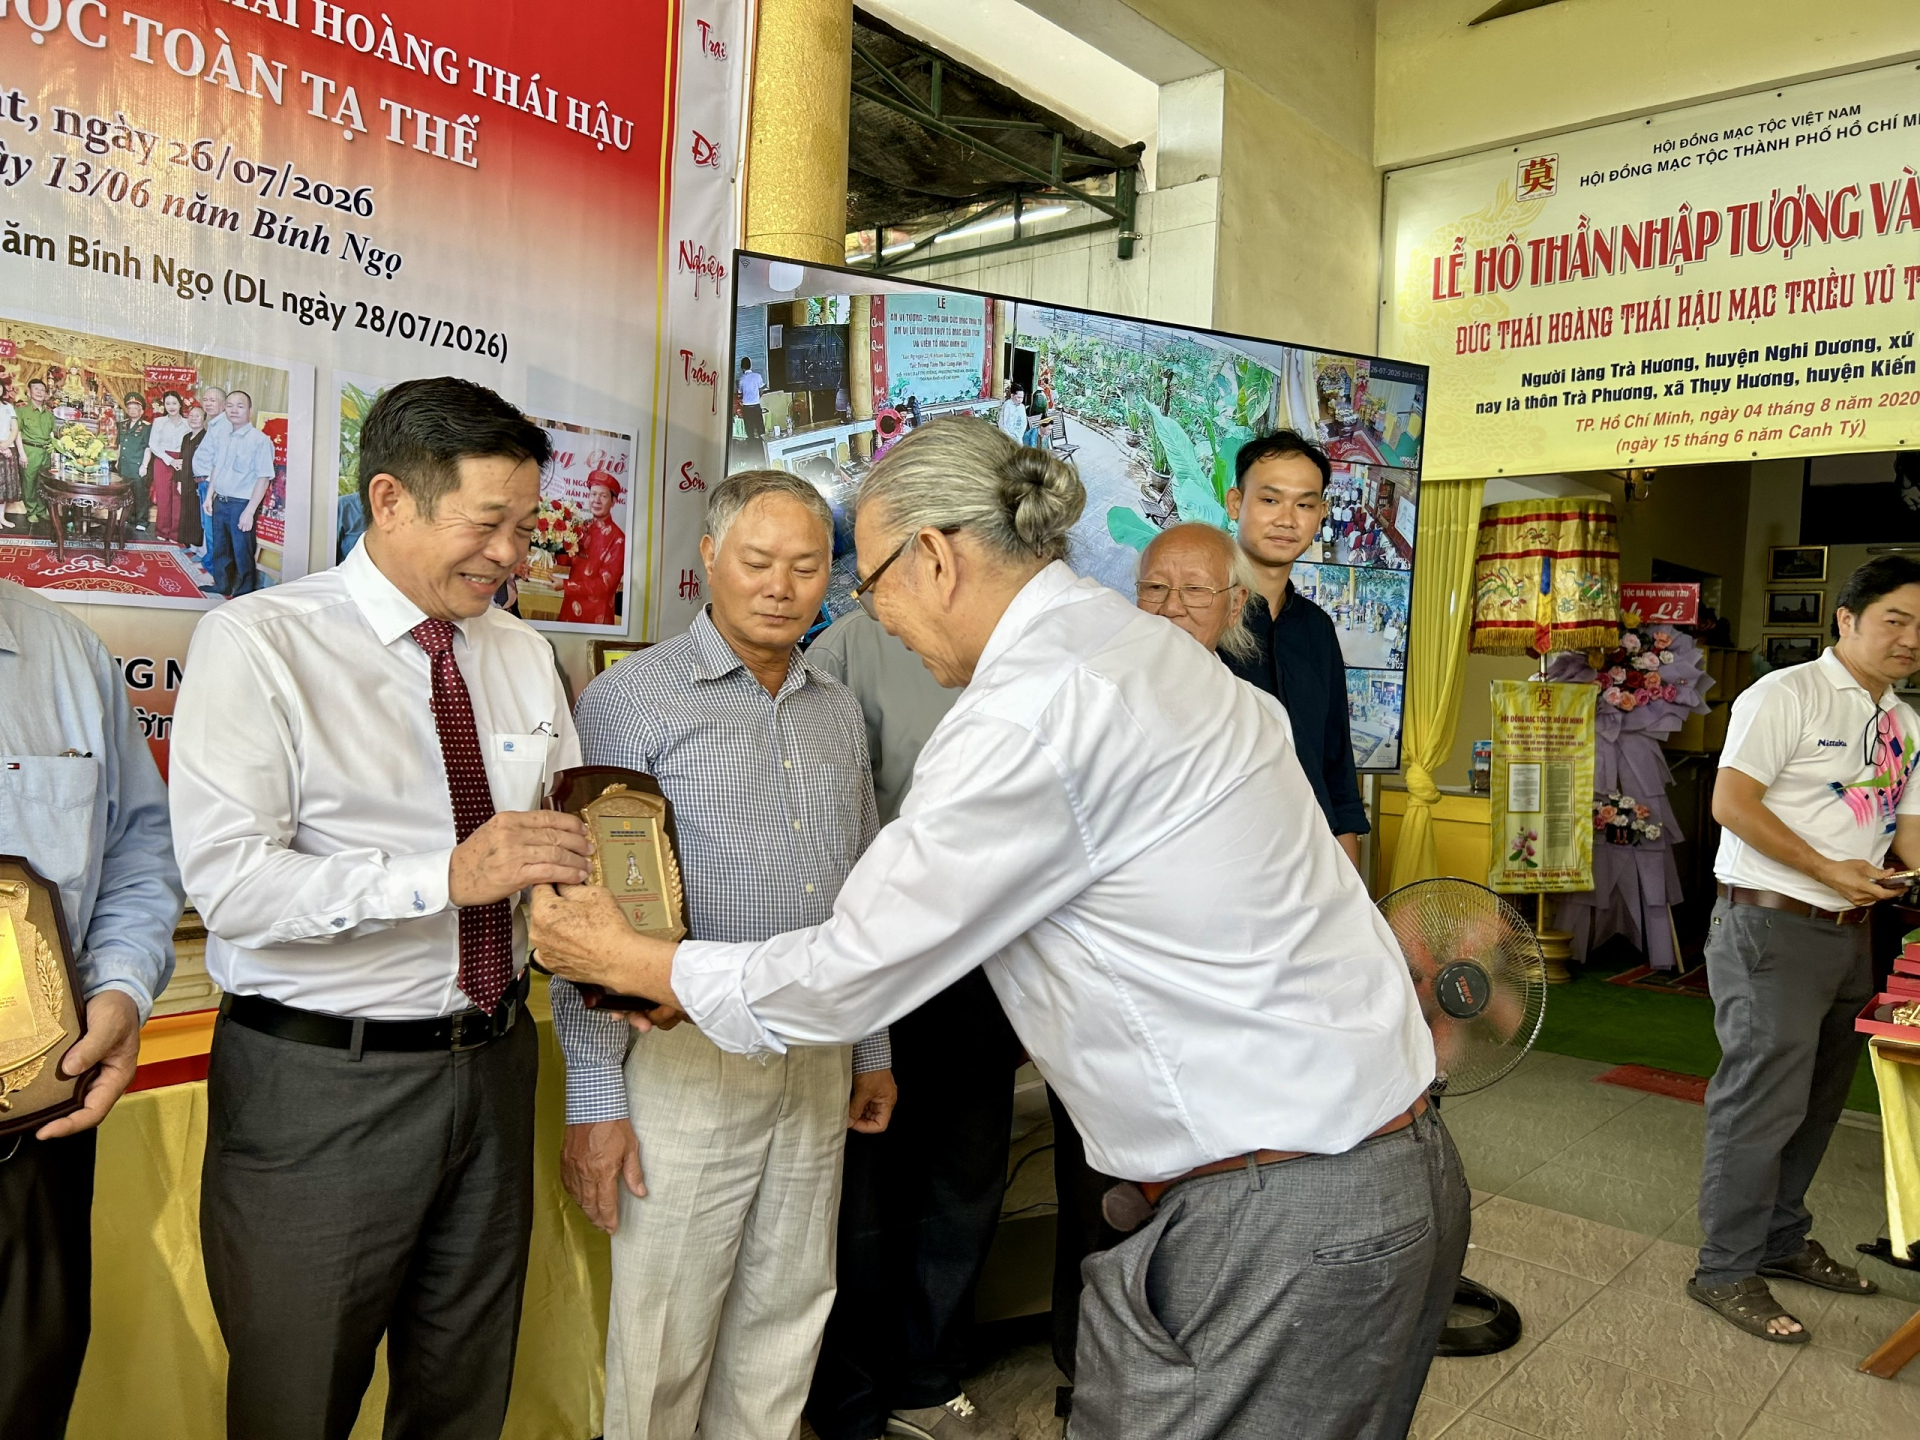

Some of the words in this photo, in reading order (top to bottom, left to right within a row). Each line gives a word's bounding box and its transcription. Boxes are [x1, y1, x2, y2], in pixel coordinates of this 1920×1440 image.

[0, 0, 107, 47] ỌC
[123, 11, 287, 105] TOÀN
[301, 70, 367, 141] TẠ
[380, 92, 480, 168] THẾ
[311, 0, 459, 84] HOÀNG
[468, 57, 558, 124] THÁI
[566, 100, 634, 151] HẬU
[53, 108, 160, 167] ngày
[168, 140, 374, 217] 26/07/2026
[1580, 171, 1605, 187] HỘI
[1609, 163, 1653, 182] ĐỒNG
[1657, 156, 1692, 172] MẠC
[1696, 149, 1728, 166] TỘC
[1734, 138, 1789, 158] THÀNH
[1795, 125, 1832, 147] PHỐ
[1837, 120, 1862, 139] HỒ
[1867, 114, 1899, 134] CHÍ
[1653, 140, 1676, 154] HỘI
[1680, 132, 1719, 148] ĐỒNG
[1723, 126, 1754, 140] MẠC
[1758, 119, 1787, 133] TỘC
[1792, 111, 1824, 127] VIỆT
[1828, 105, 1861, 120] NAM
[45, 156, 152, 208] 13/06
[161, 191, 240, 232] năm
[249, 207, 330, 255] Bính
[339, 231, 402, 280] Ngọ
[1432, 236, 1465, 302] LỄ
[1473, 233, 1523, 295] HÔ
[1527, 213, 1616, 287] THẦN
[1620, 202, 1721, 275] NHẬP
[1726, 184, 1862, 260] TƯỢNG
[67, 234, 142, 280] Bính
[152, 253, 214, 301] Ngọ
[223, 269, 274, 305] (DL
[282, 290, 347, 331] ngày
[354, 301, 508, 364] 28/07/2026)
[1456, 321, 1491, 355] ĐỨC
[1497, 313, 1543, 350] THÁI
[1548, 306, 1614, 345] HOÀNG
[1621, 295, 1671, 335] THÁI
[1677, 289, 1723, 331] HẬU
[1728, 284, 1778, 325] MẠC
[1785, 267, 1856, 315] TRIỀU
[1864, 264, 1896, 306] VŨ
[680, 349, 717, 412] Tráng
[1476, 401, 1502, 415] nay
[1506, 397, 1521, 412] là
[1525, 393, 1558, 410] thôn
[1563, 390, 1587, 406] Trà
[1592, 386, 1659, 404] Phương,
[1663, 380, 1685, 398] xã
[1690, 377, 1732, 396] Thụy
[1736, 371, 1801, 390] Hương,
[1806, 363, 1865, 384] huyện
[1871, 355, 1916, 378] Kiến
[1521, 368, 1566, 388] Người
[1571, 366, 1606, 384] làng
[1611, 361, 1636, 378] Trà
[1641, 356, 1700, 375] Hương,
[1705, 349, 1759, 368] huyện
[1765, 342, 1809, 362] Nghi
[1815, 337, 1882, 357] Dương,
[1888, 331, 1915, 350] xứ
[1576, 418, 1595, 433] TP.
[1600, 414, 1621, 431] Hồ
[1624, 412, 1651, 429] Chí
[1653, 410, 1695, 427] Minh,
[1700, 406, 1740, 425] ngày
[1743, 404, 1763, 419] 04
[1767, 400, 1816, 417] tháng
[1820, 398, 1831, 412] 8
[1835, 395, 1873, 411] năm
[1878, 391, 1920, 408] 2020
[1616, 435, 1659, 455] (ngày
[1663, 434, 1681, 449] 15
[1684, 430, 1730, 448] tháng
[1733, 429, 1744, 444] 6
[1747, 427, 1783, 443] năm
[1788, 422, 1833, 440] Canh
[1840, 419, 1867, 439] Tý)
[1650, 602, 1685, 620] Lễ
